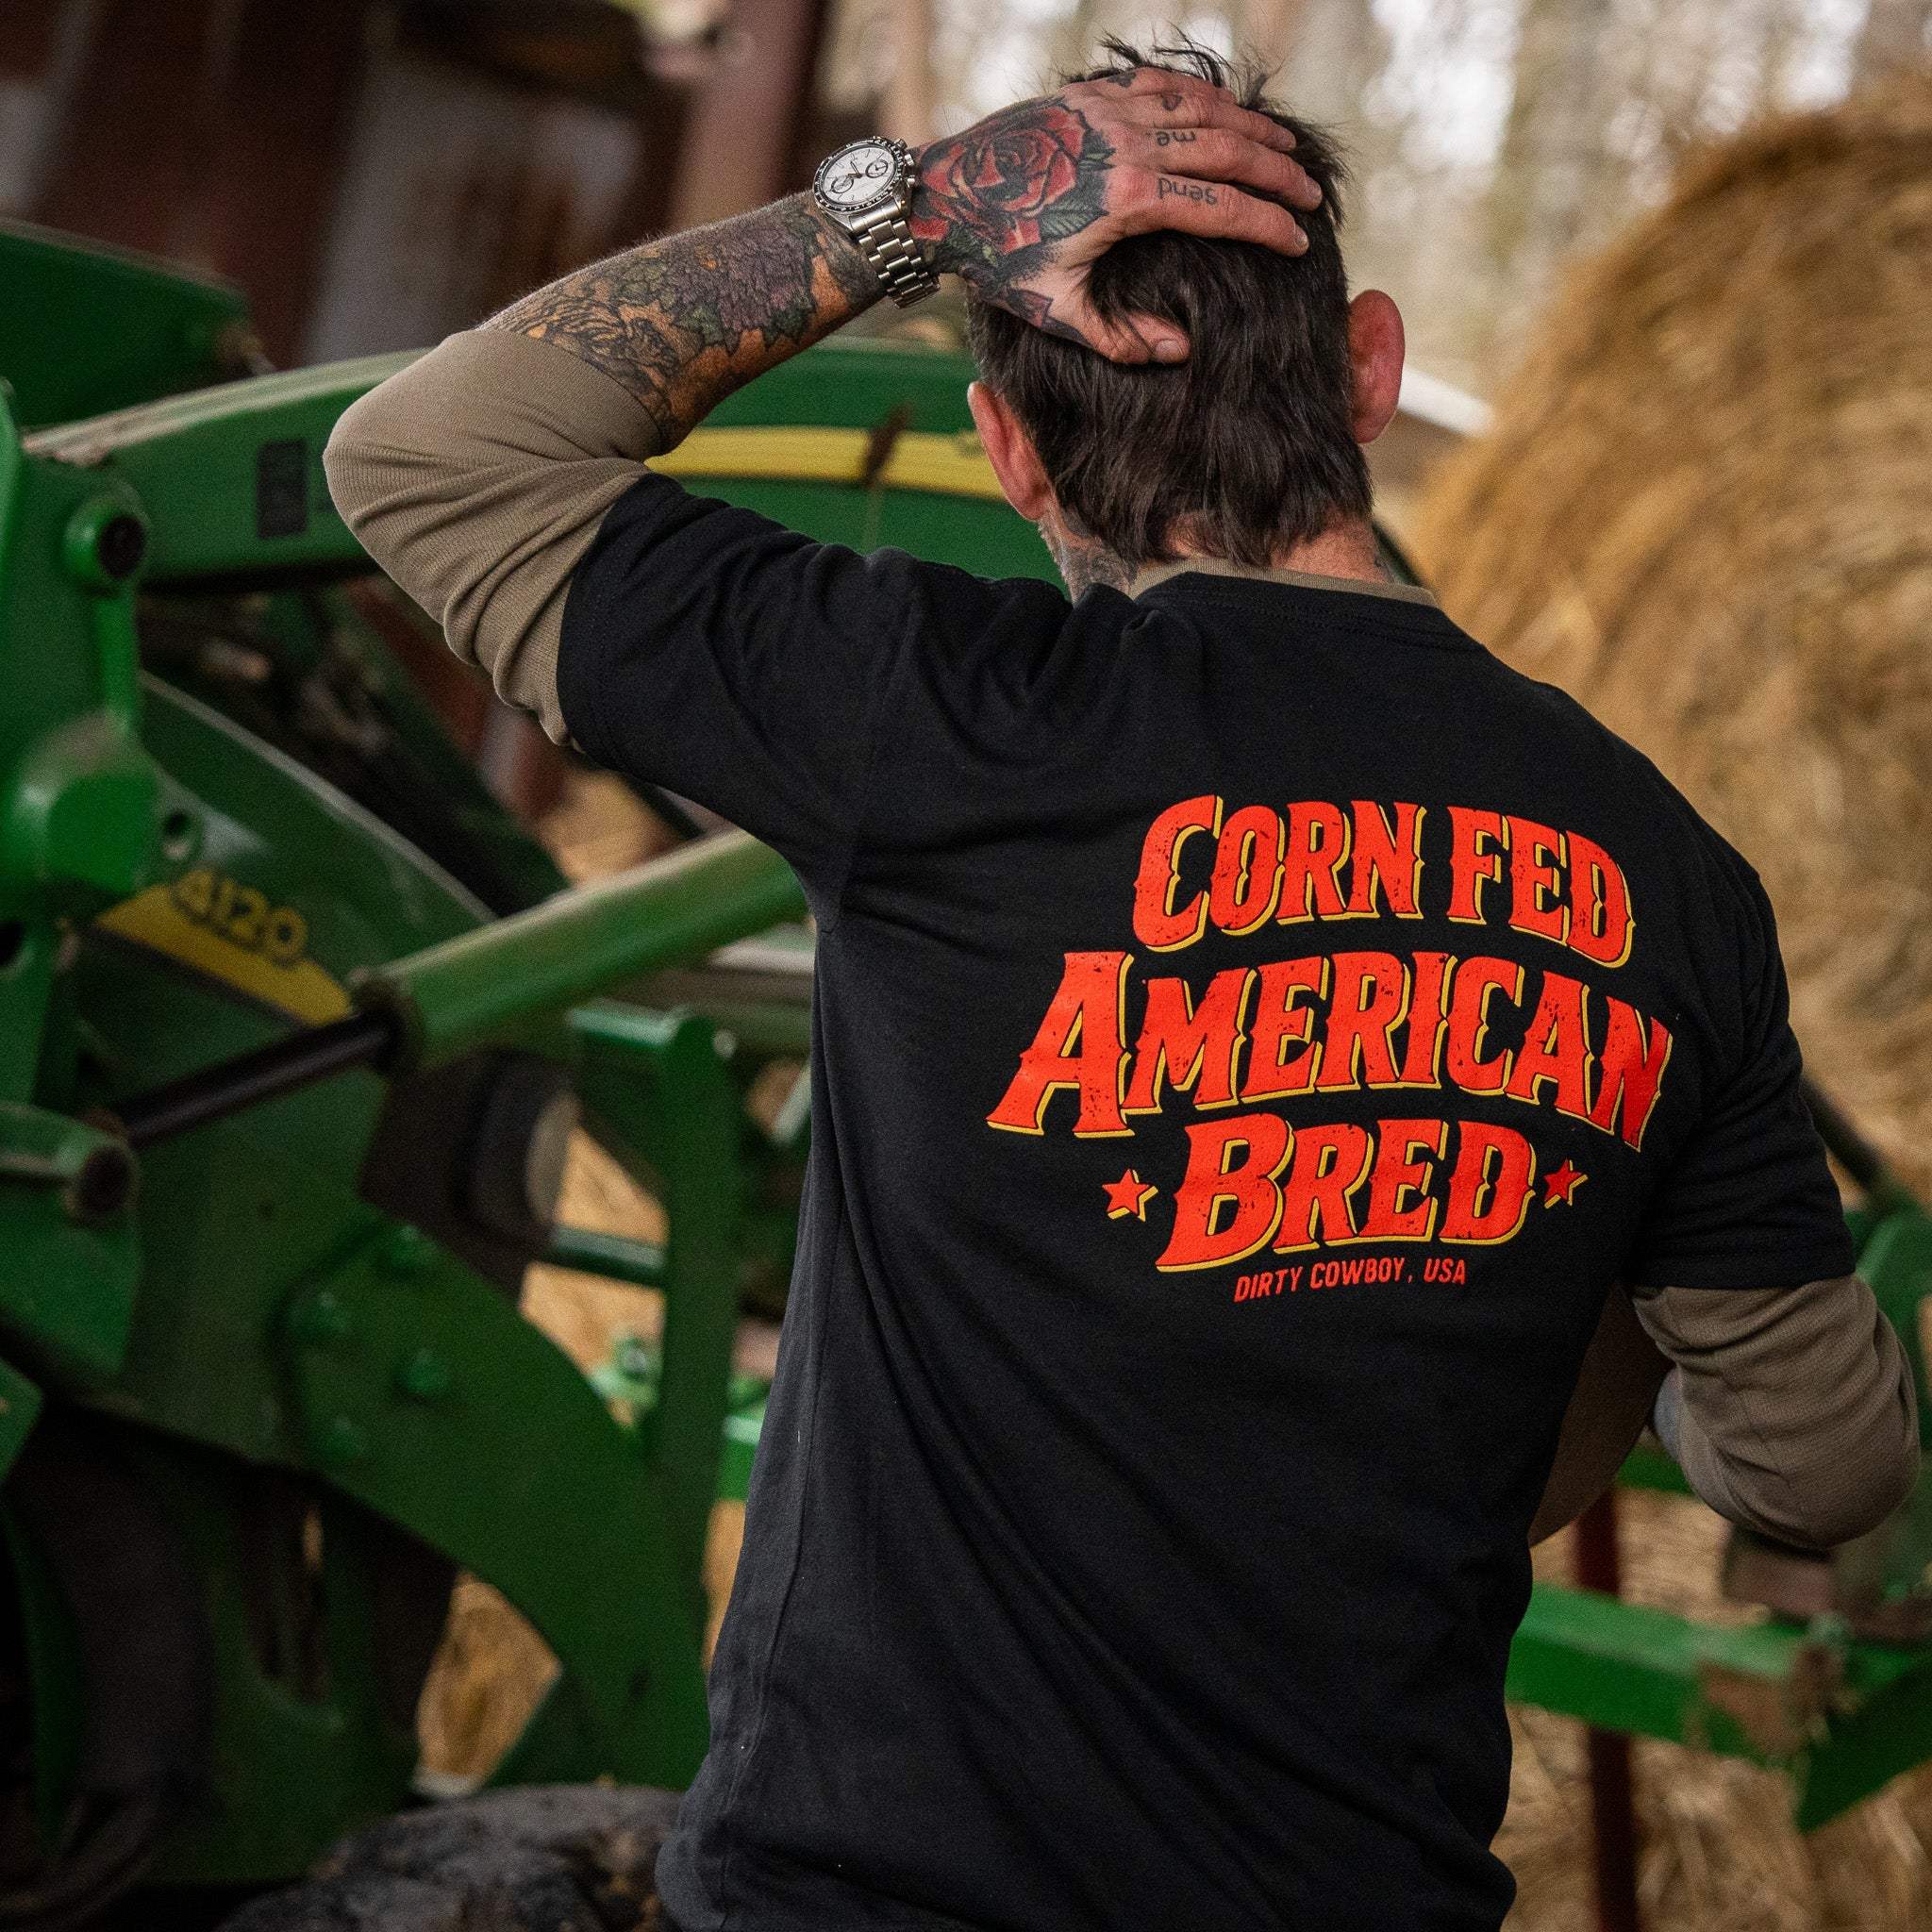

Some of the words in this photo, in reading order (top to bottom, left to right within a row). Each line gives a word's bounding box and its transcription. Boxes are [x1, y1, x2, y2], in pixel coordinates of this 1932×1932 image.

[1158, 177, 1218, 206] send
[1132, 794, 1425, 952] CORN
[1447, 806, 1636, 969] FED
[987, 950, 1673, 1152] AMERICAN
[1157, 1113, 1536, 1272] BRED
[1234, 1267, 1302, 1302] DIRTY
[1309, 1257, 1415, 1289] COWBOY,
[1424, 1257, 1467, 1285] USA
